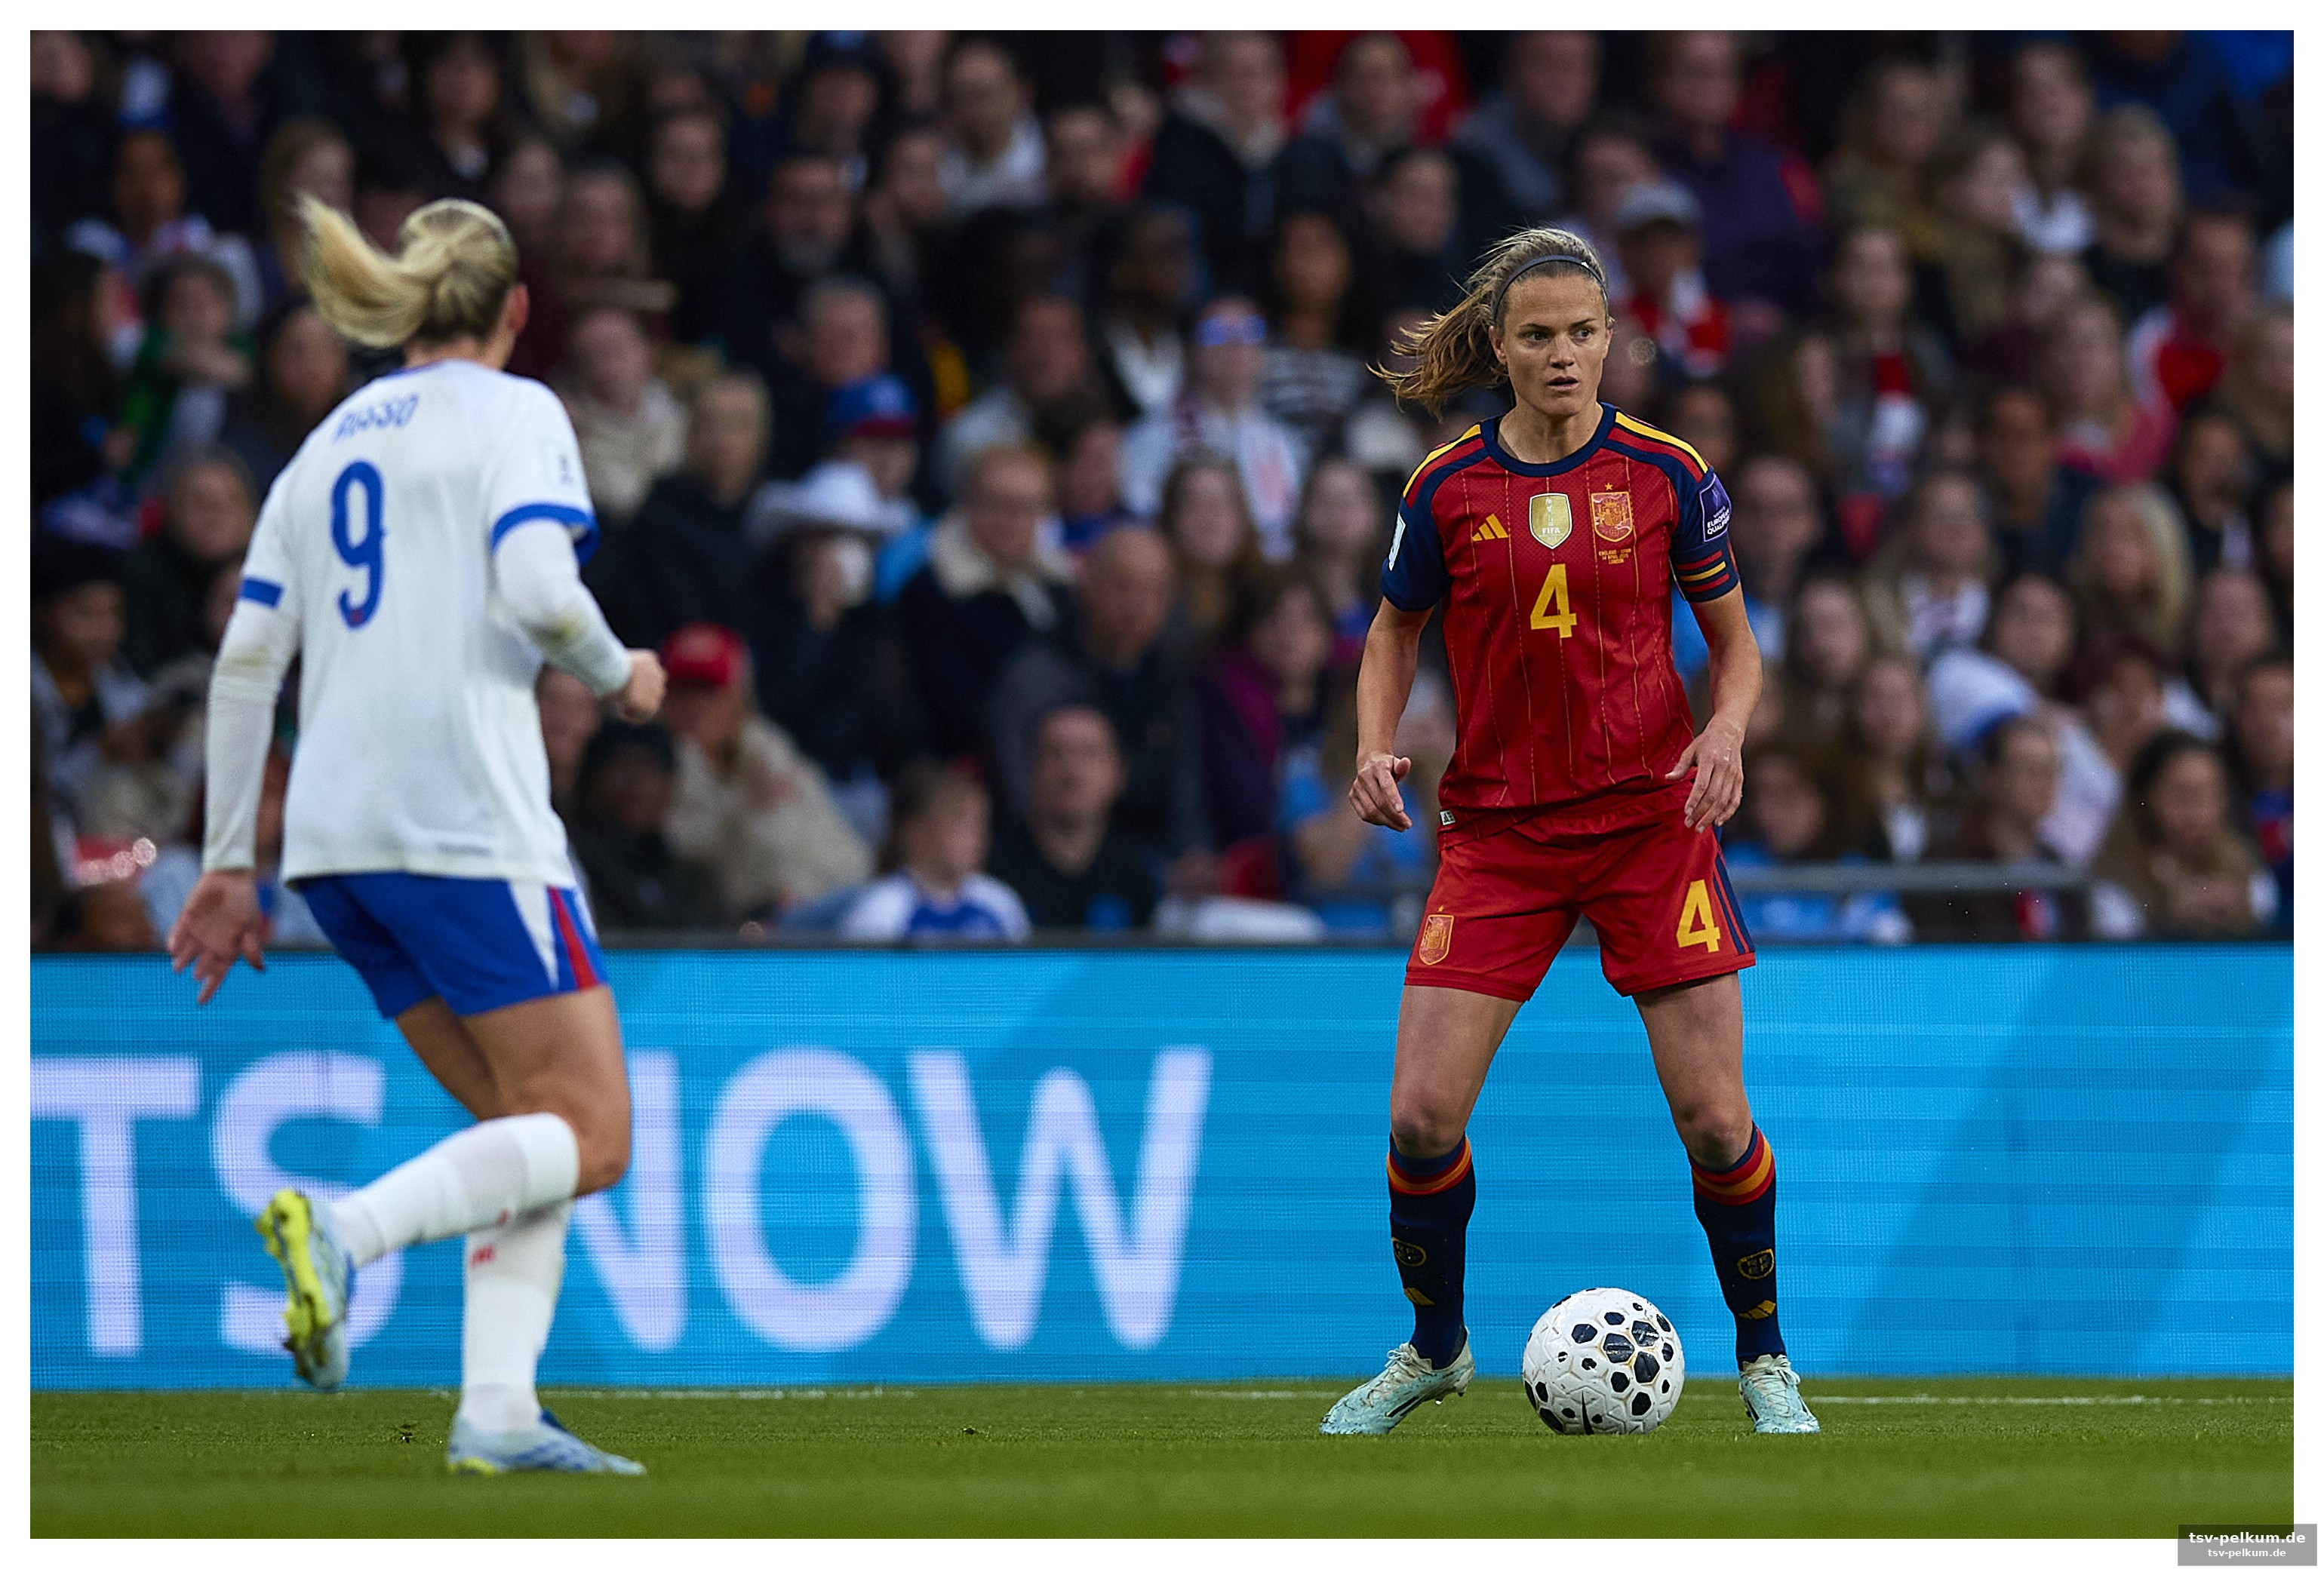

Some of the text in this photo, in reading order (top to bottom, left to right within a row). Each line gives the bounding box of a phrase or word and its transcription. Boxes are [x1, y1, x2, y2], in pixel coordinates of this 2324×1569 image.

[330, 459, 386, 631] 9
[1529, 563, 1578, 638] 4
[1676, 879, 1721, 953] 4
[567, 1044, 1212, 1352] NOW
